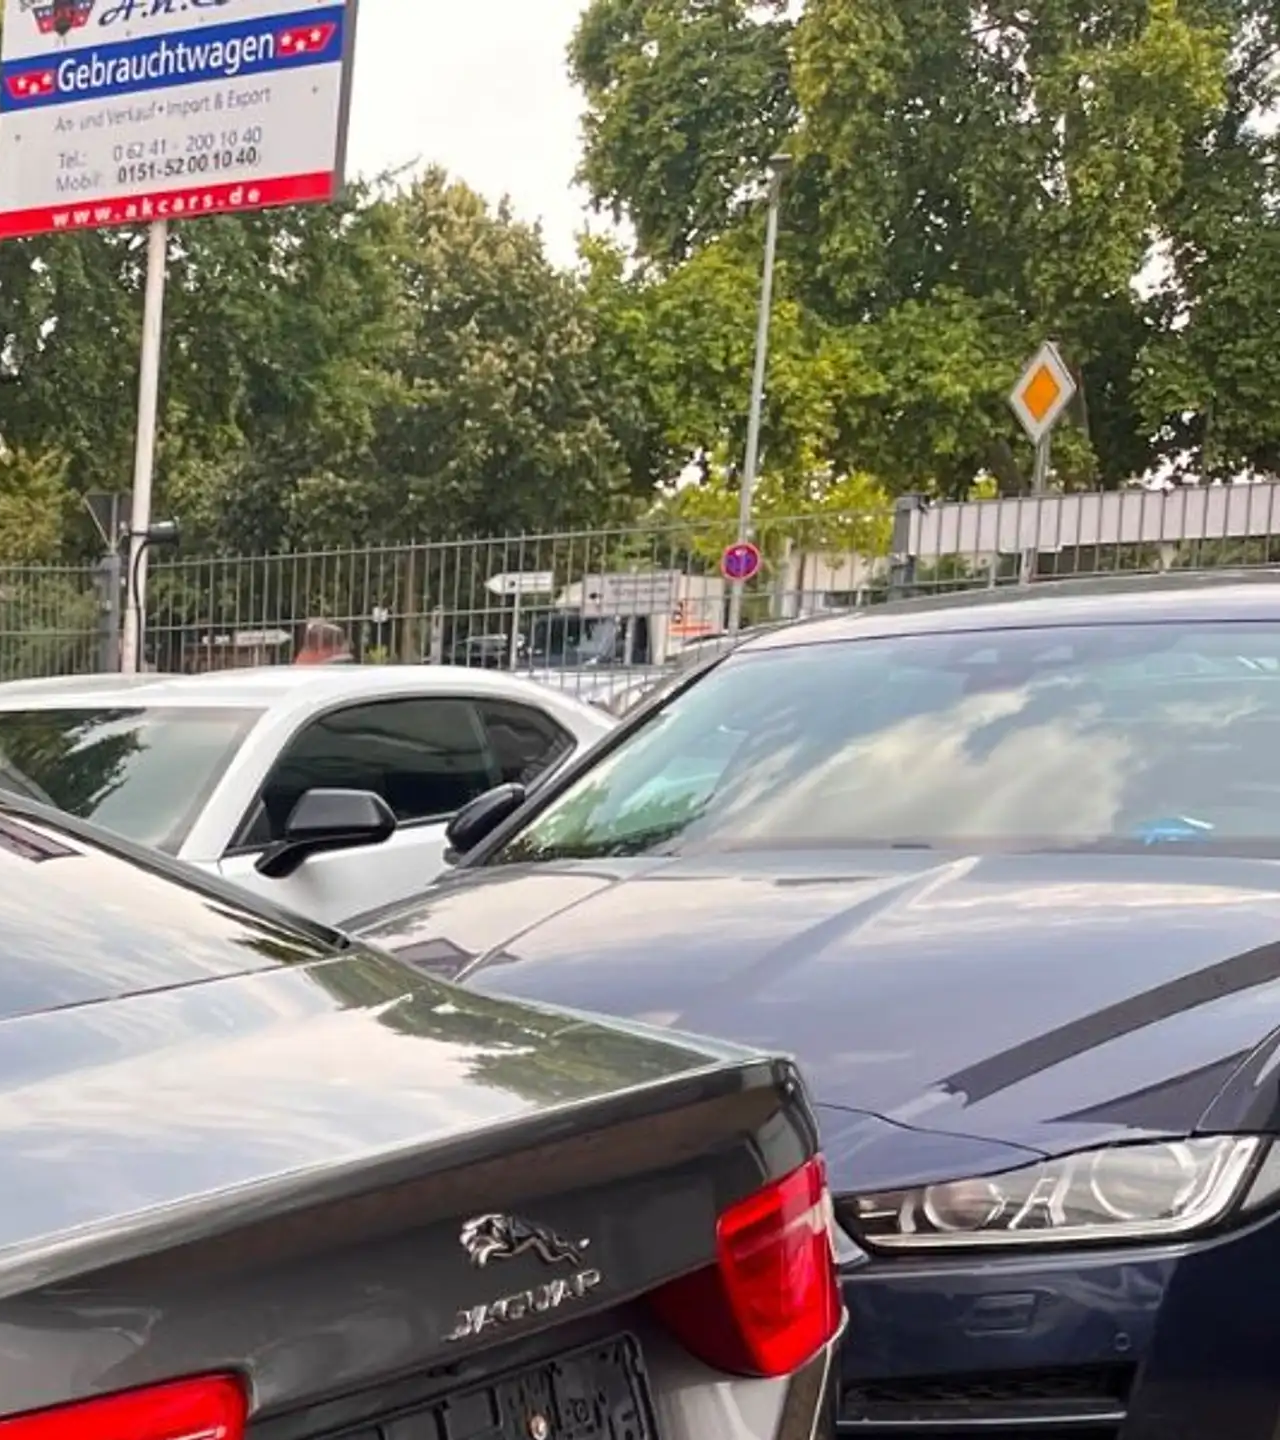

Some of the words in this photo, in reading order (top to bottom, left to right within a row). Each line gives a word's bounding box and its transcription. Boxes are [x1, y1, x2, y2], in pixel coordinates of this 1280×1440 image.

[57, 32, 275, 92] Gebrauchtwagen
[80, 108, 104, 131] und
[106, 101, 157, 126] Verkauf
[167, 96, 211, 119] Import
[214, 92, 224, 110] &
[227, 87, 271, 110] Export
[52, 186, 262, 228] www.akcars.de
[441, 1268, 601, 1342] JAGUAR
